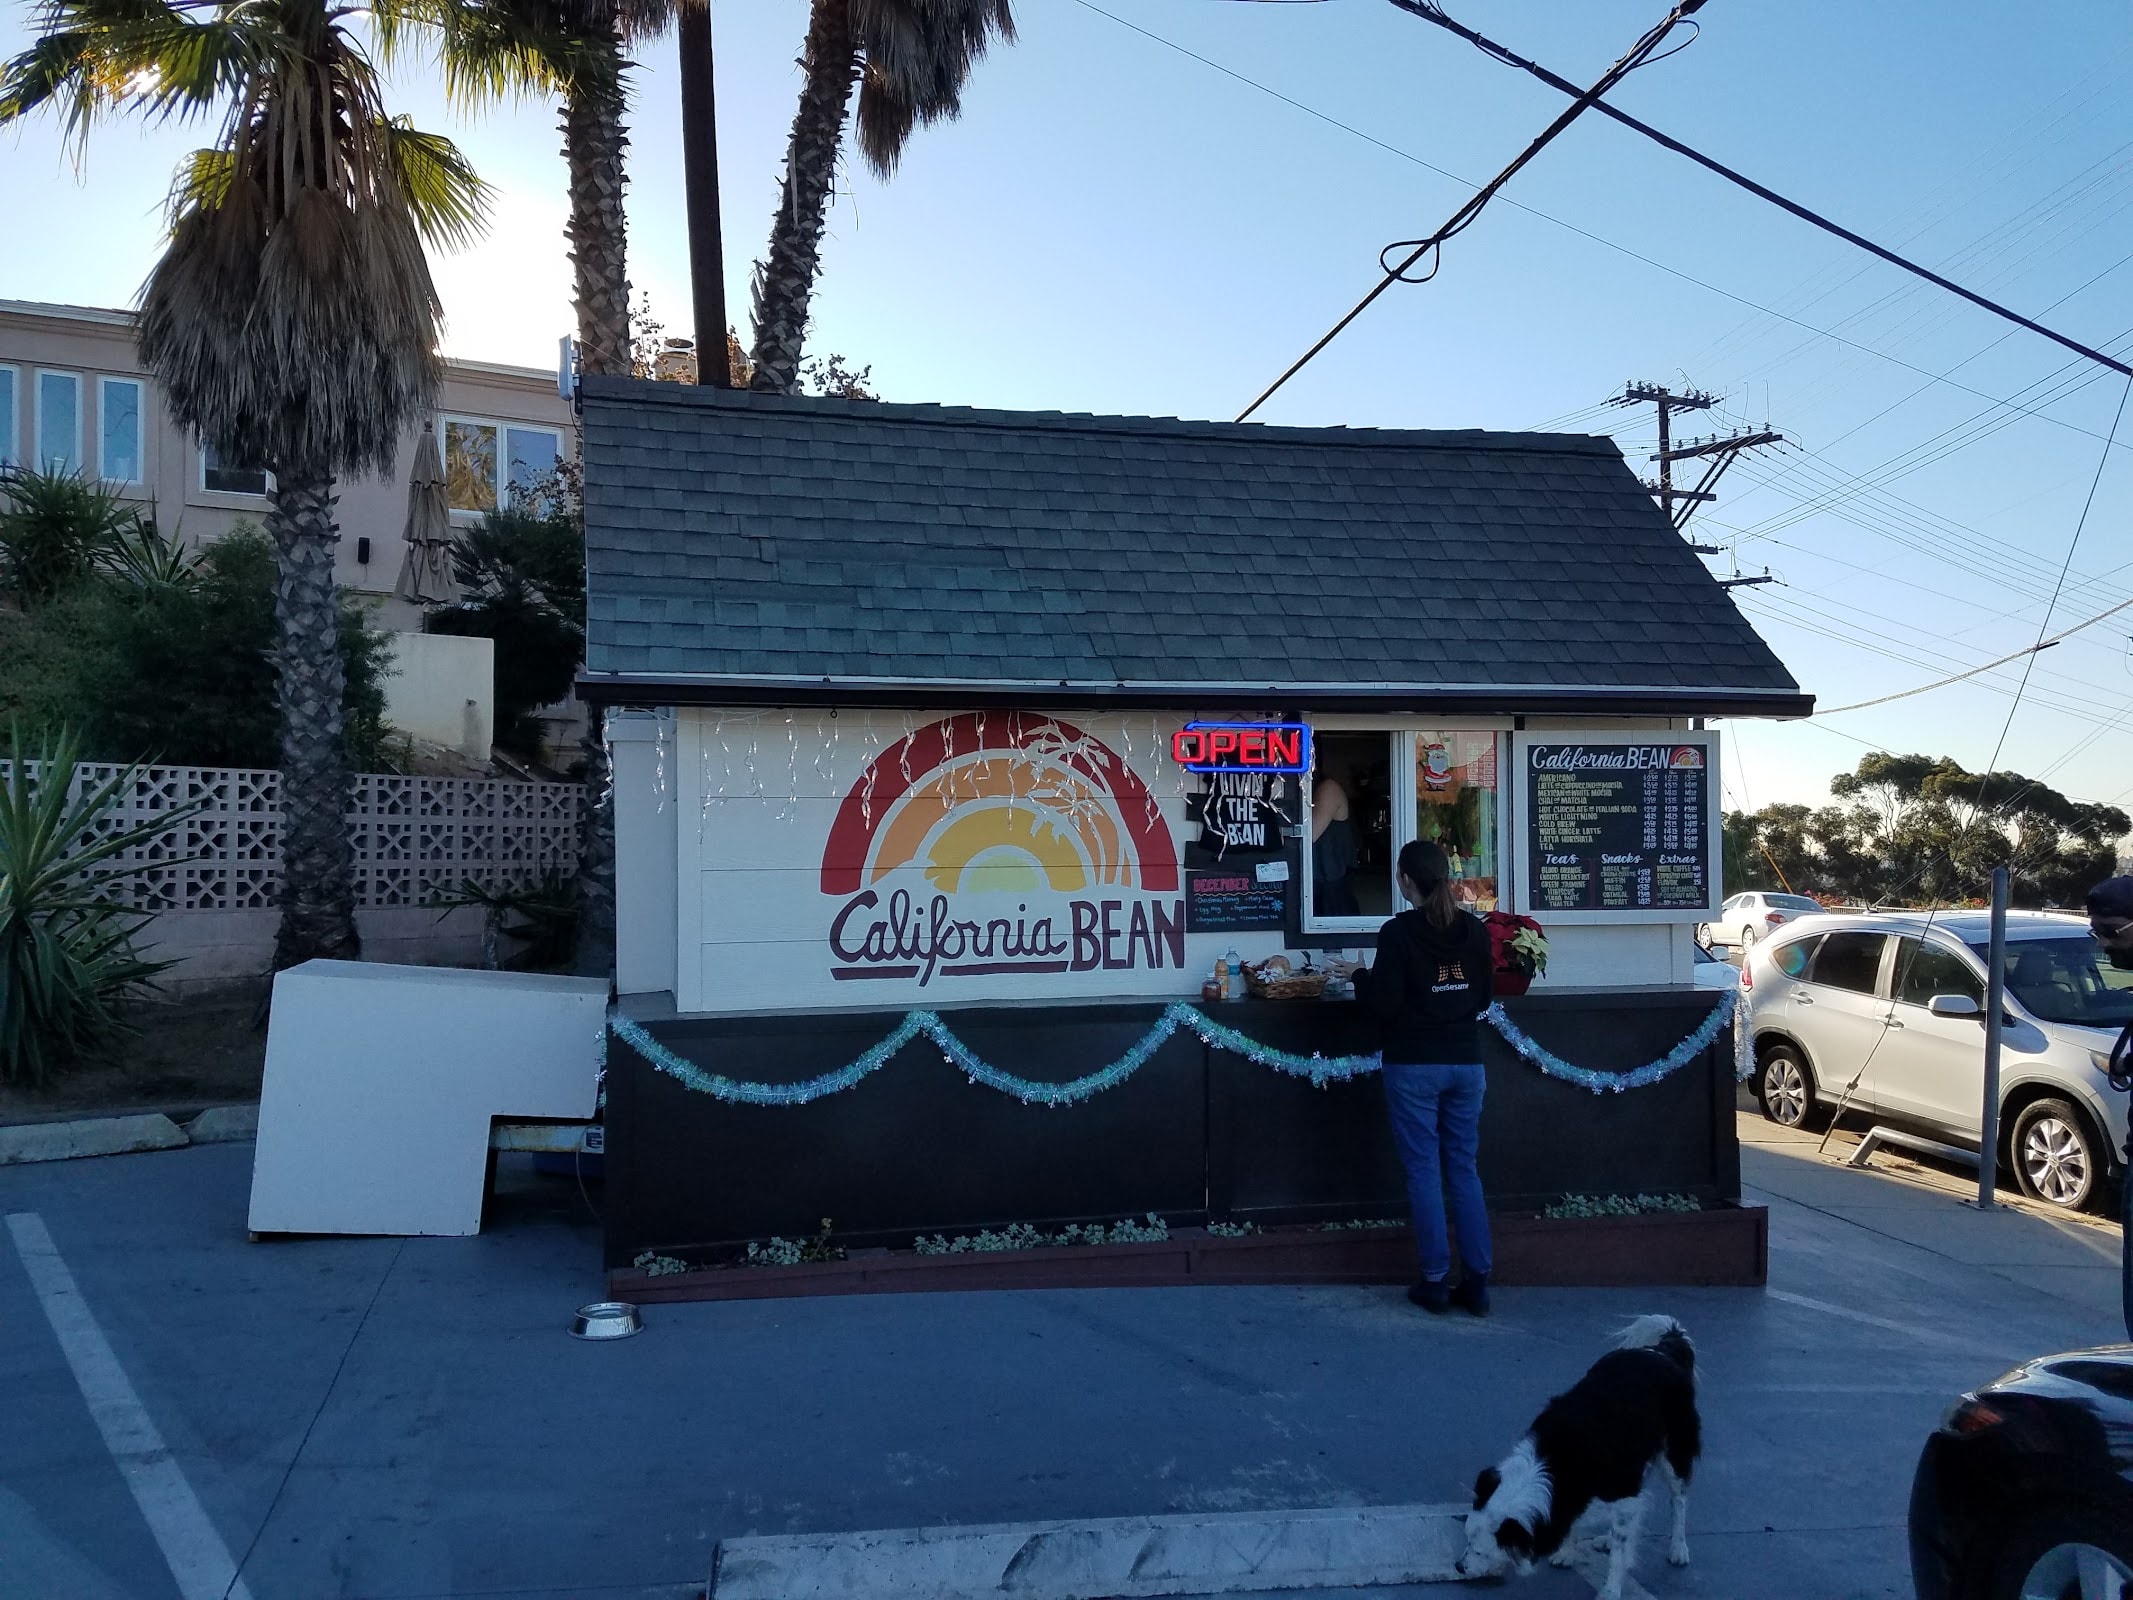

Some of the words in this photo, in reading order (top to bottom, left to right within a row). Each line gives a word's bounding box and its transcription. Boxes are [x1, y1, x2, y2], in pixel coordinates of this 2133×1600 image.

[1171, 731, 1299, 764] OPEN
[1532, 746, 1627, 771] California
[1626, 747, 1671, 769] BEAN
[1538, 773, 1576, 782] AMERICANO
[1226, 798, 1259, 821] THE
[1539, 805, 1552, 813] HOT
[1553, 805, 1588, 813] CHOCOLATE
[1539, 813, 1559, 821] WHITE
[1560, 813, 1598, 821] LIGHTNING
[1539, 820, 1555, 828] COLD
[1227, 823, 1265, 846] BEAN
[1545, 854, 1580, 864] Teas
[1601, 852, 1643, 864] Snacks
[1659, 854, 1698, 864] Extras
[1193, 878, 1249, 892] DECEMBER
[829, 889, 1068, 987] California
[1070, 899, 1185, 972] BEAN
